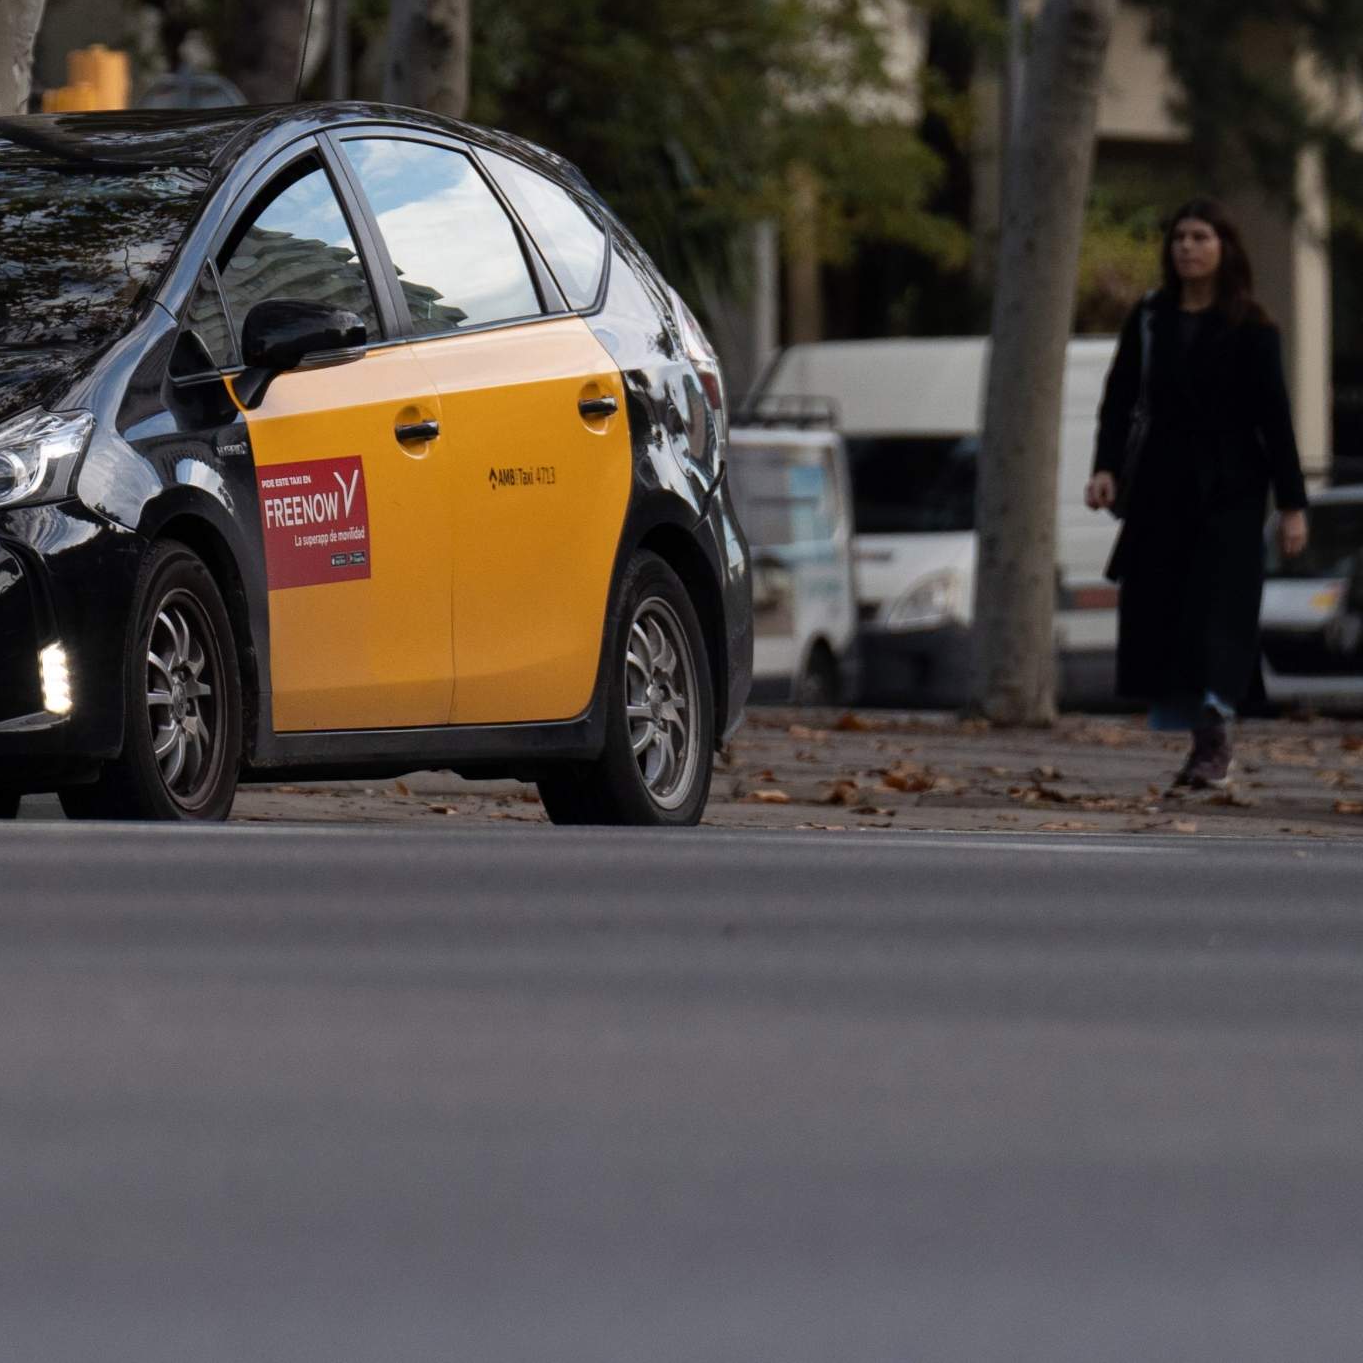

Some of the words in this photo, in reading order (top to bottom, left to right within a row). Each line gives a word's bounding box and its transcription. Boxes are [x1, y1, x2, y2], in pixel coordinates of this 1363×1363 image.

[264, 491, 339, 529] FREENOW
[294, 534, 302, 547] La
[303, 533, 329, 548] superapp
[330, 529, 338, 542] de
[338, 526, 365, 541] movilidad
